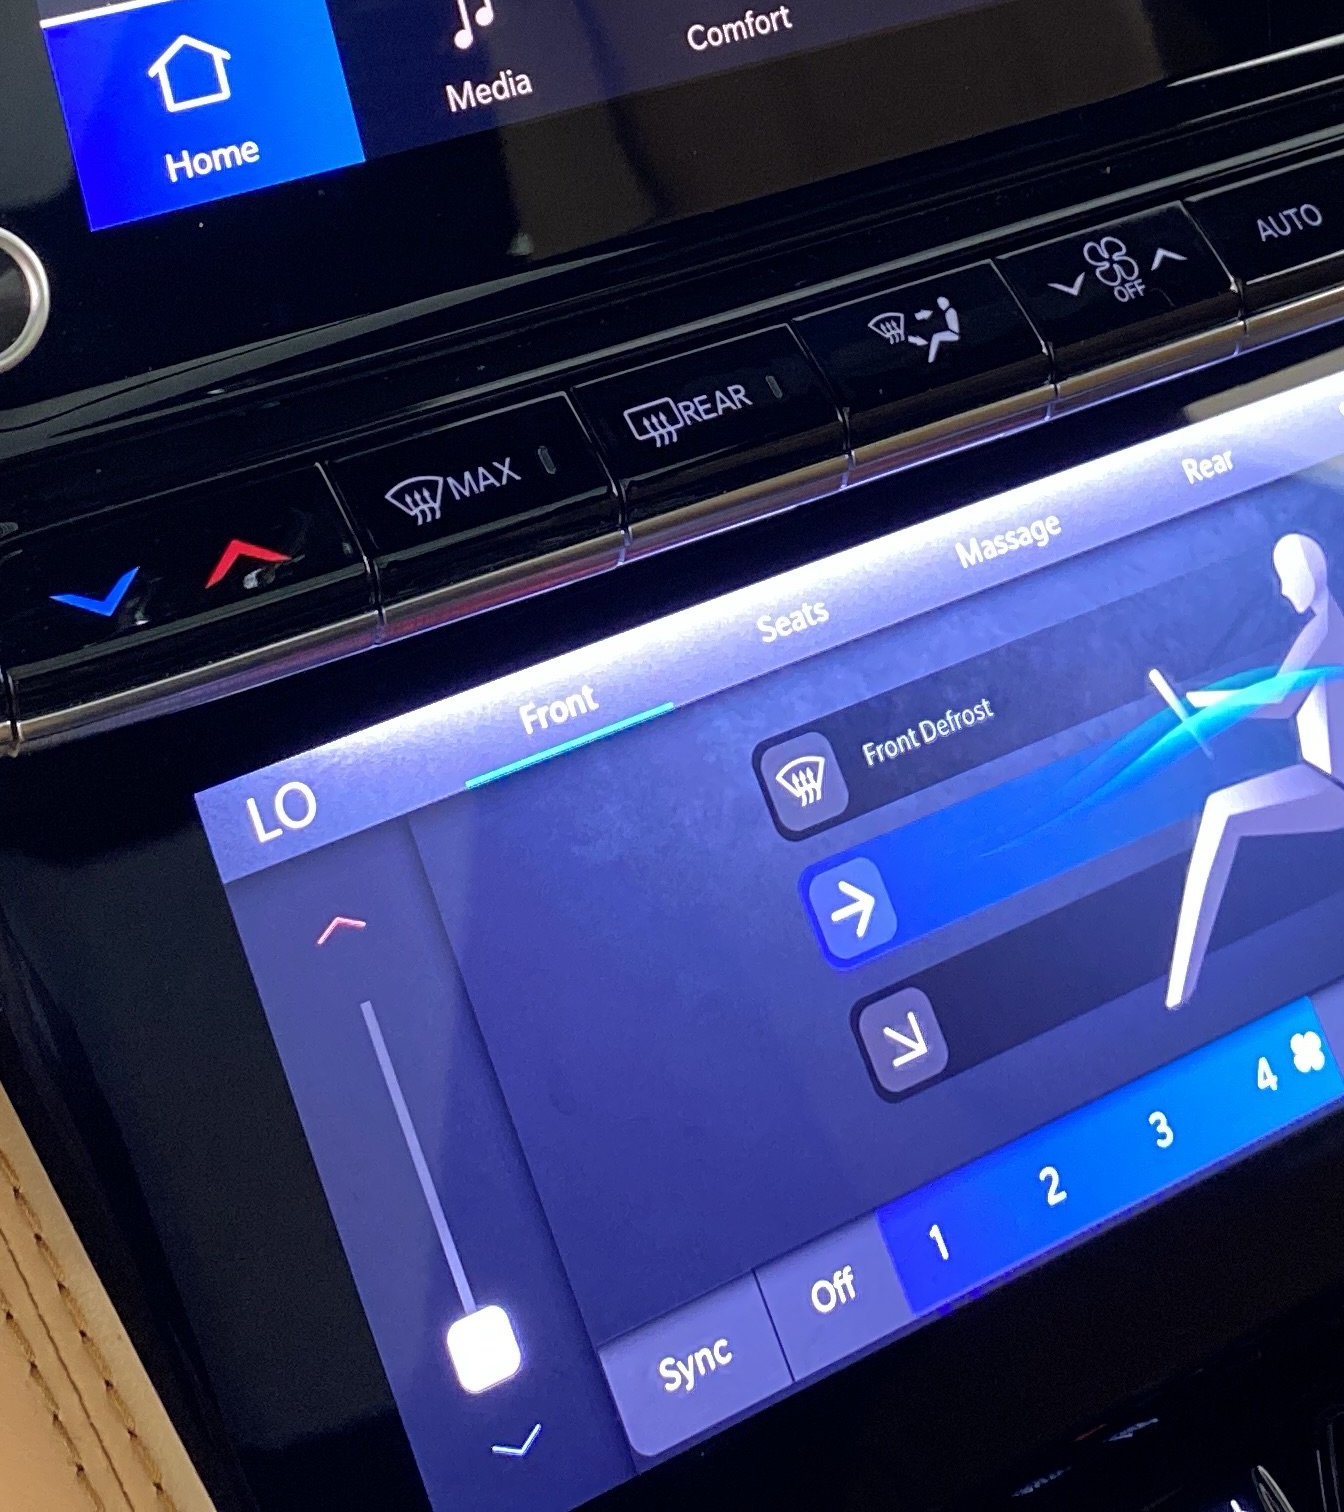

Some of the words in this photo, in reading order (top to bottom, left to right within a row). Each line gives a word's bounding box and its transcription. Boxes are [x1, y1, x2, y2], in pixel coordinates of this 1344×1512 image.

[688, 6, 792, 50] Comfort
[446, 70, 532, 112] Media
[166, 141, 260, 182] Home
[1257, 204, 1322, 241] AUTO
[1112, 280, 1146, 303] OFF
[678, 385, 752, 425] REAR
[447, 457, 521, 500] MAX
[1180, 448, 1234, 485] Rear
[954, 513, 1063, 569] Massage
[754, 598, 830, 643] Seats
[518, 682, 601, 736] Front
[862, 719, 920, 768] Front
[919, 699, 994, 743] Defrost
[247, 782, 316, 842] LO
[1258, 1057, 1277, 1090] 4
[1149, 1112, 1173, 1148] 3
[1039, 1167, 1067, 1205] 2
[930, 1225, 948, 1259] 1
[812, 1266, 855, 1313] Off
[658, 1338, 733, 1392] Sync
